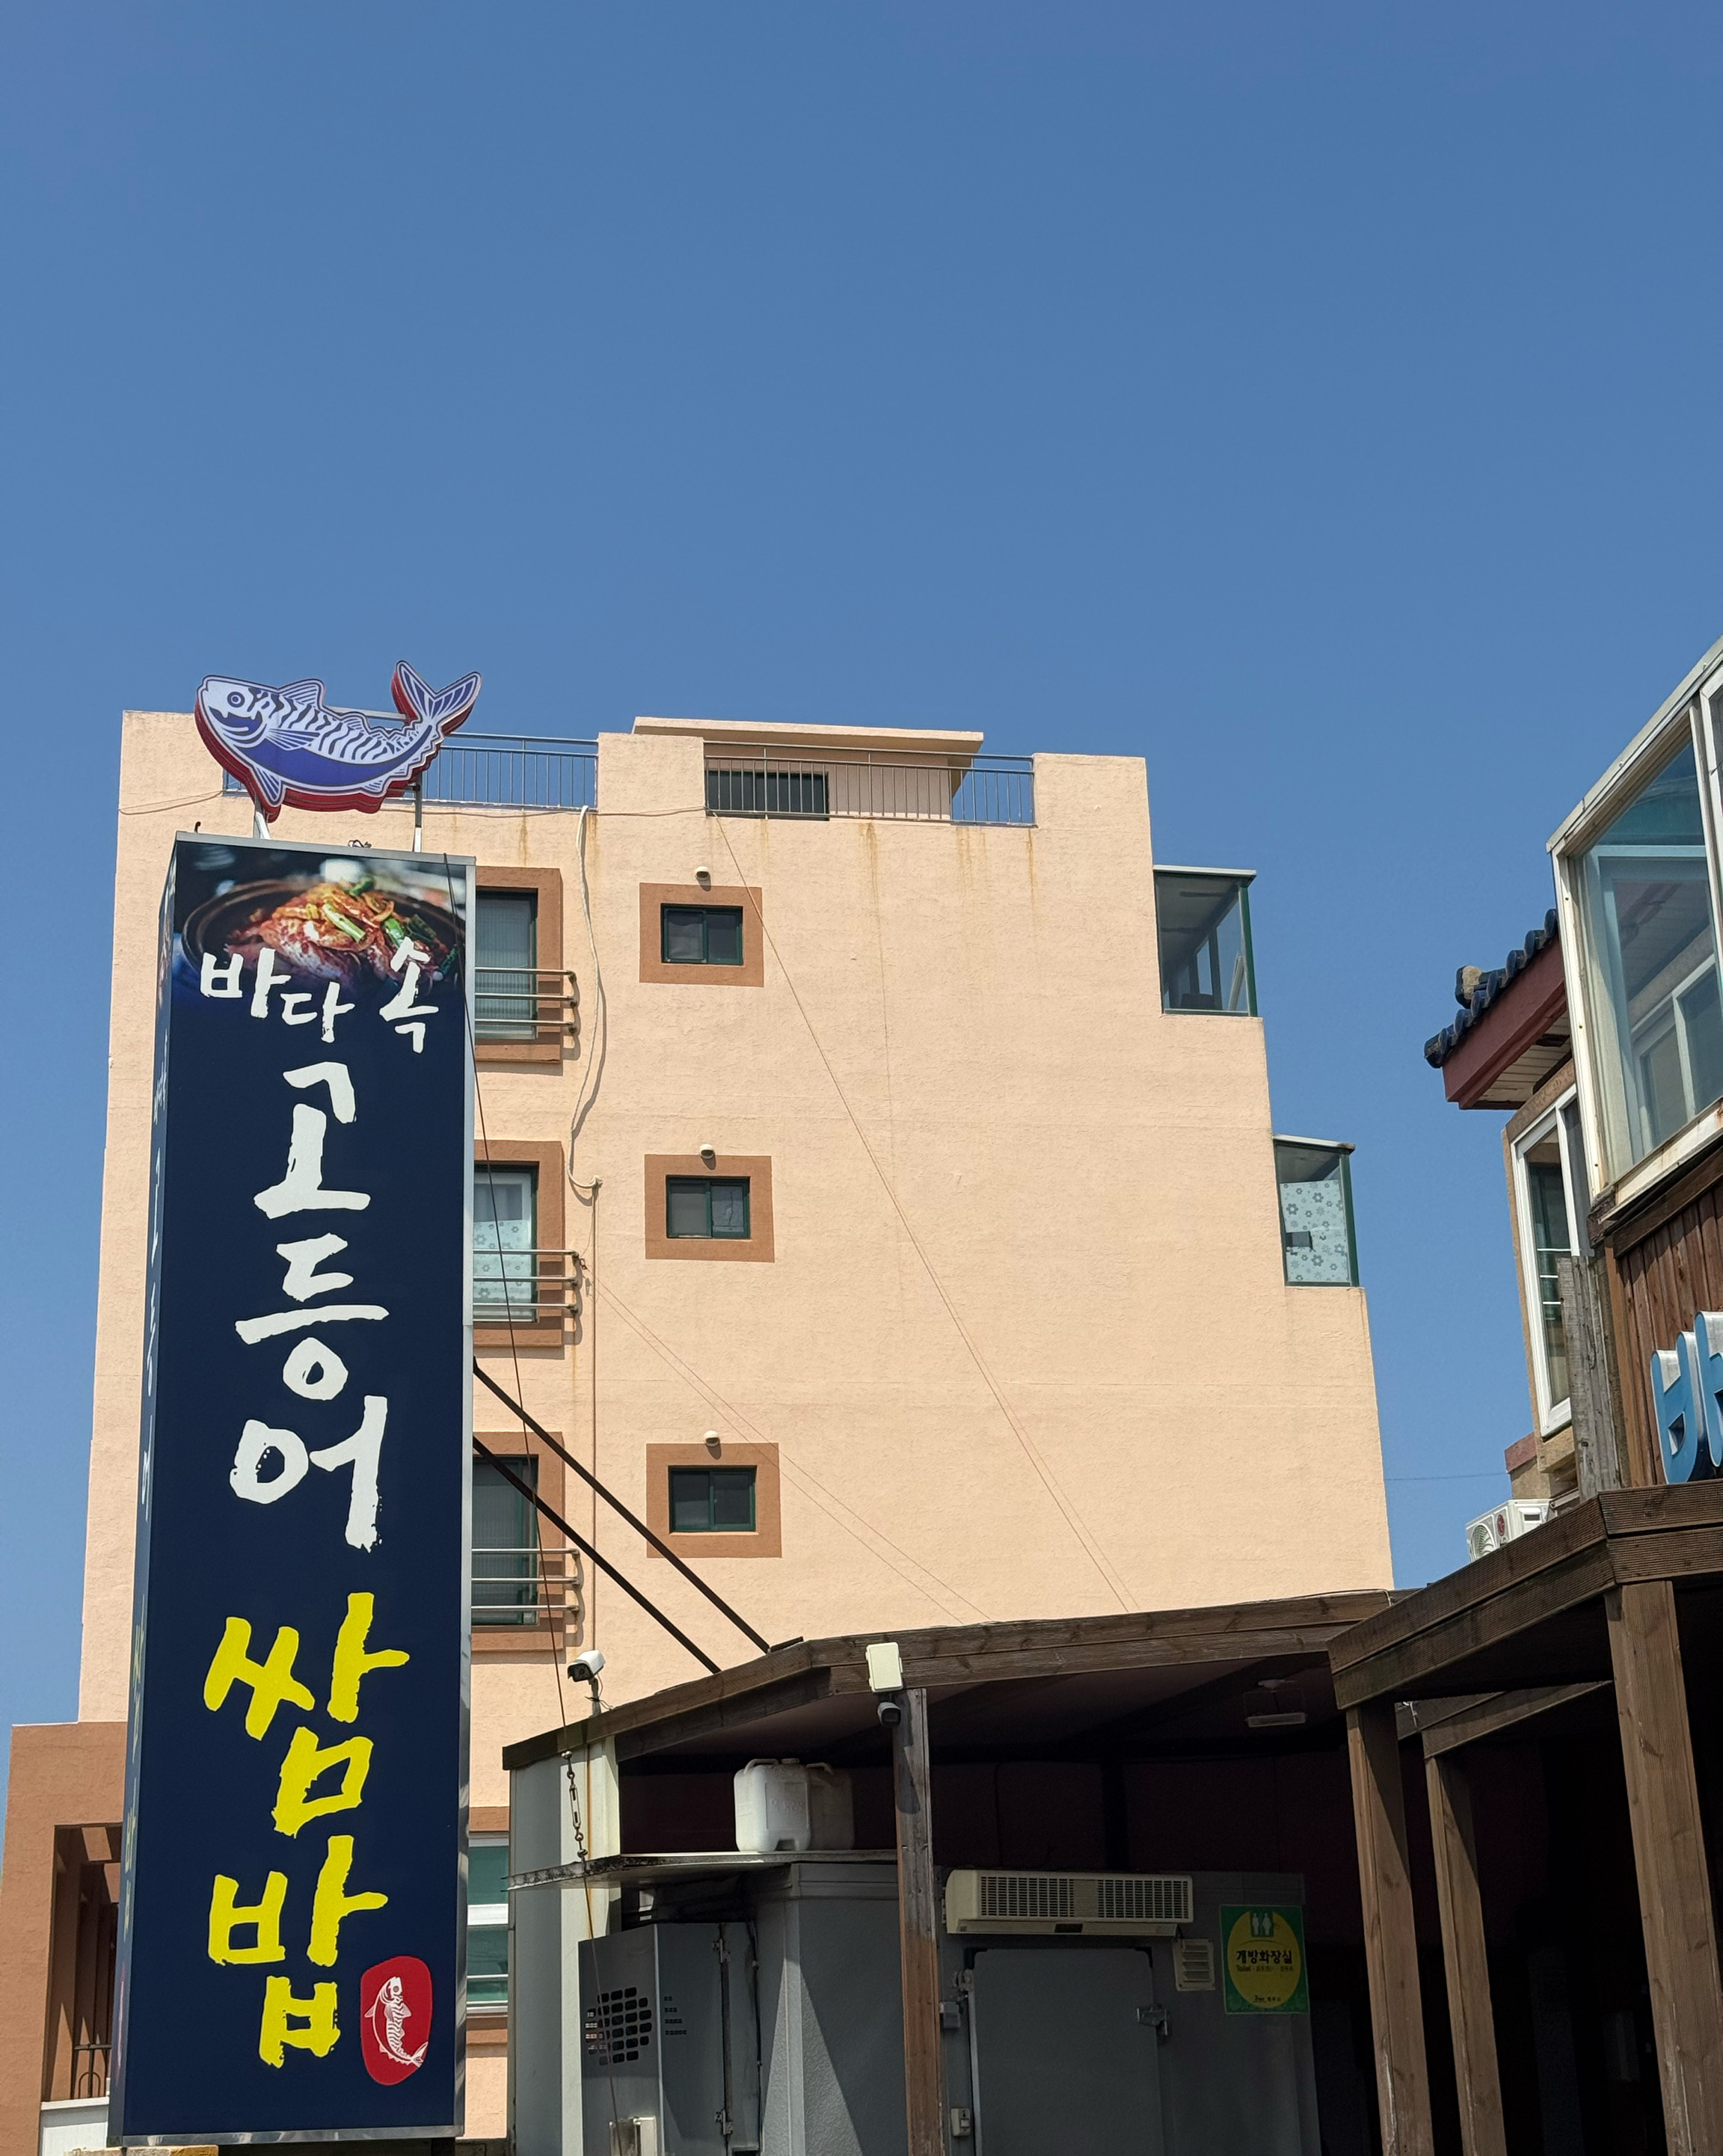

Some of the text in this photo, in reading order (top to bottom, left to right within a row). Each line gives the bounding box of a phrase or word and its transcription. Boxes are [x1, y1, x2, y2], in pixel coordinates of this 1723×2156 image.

[200, 936, 439, 1054] 바다 속
[230, 1061, 390, 1553] 고등어
[203, 1592, 410, 2068] 쌈밥
[1236, 1950, 1293, 1965] 개방화장실
